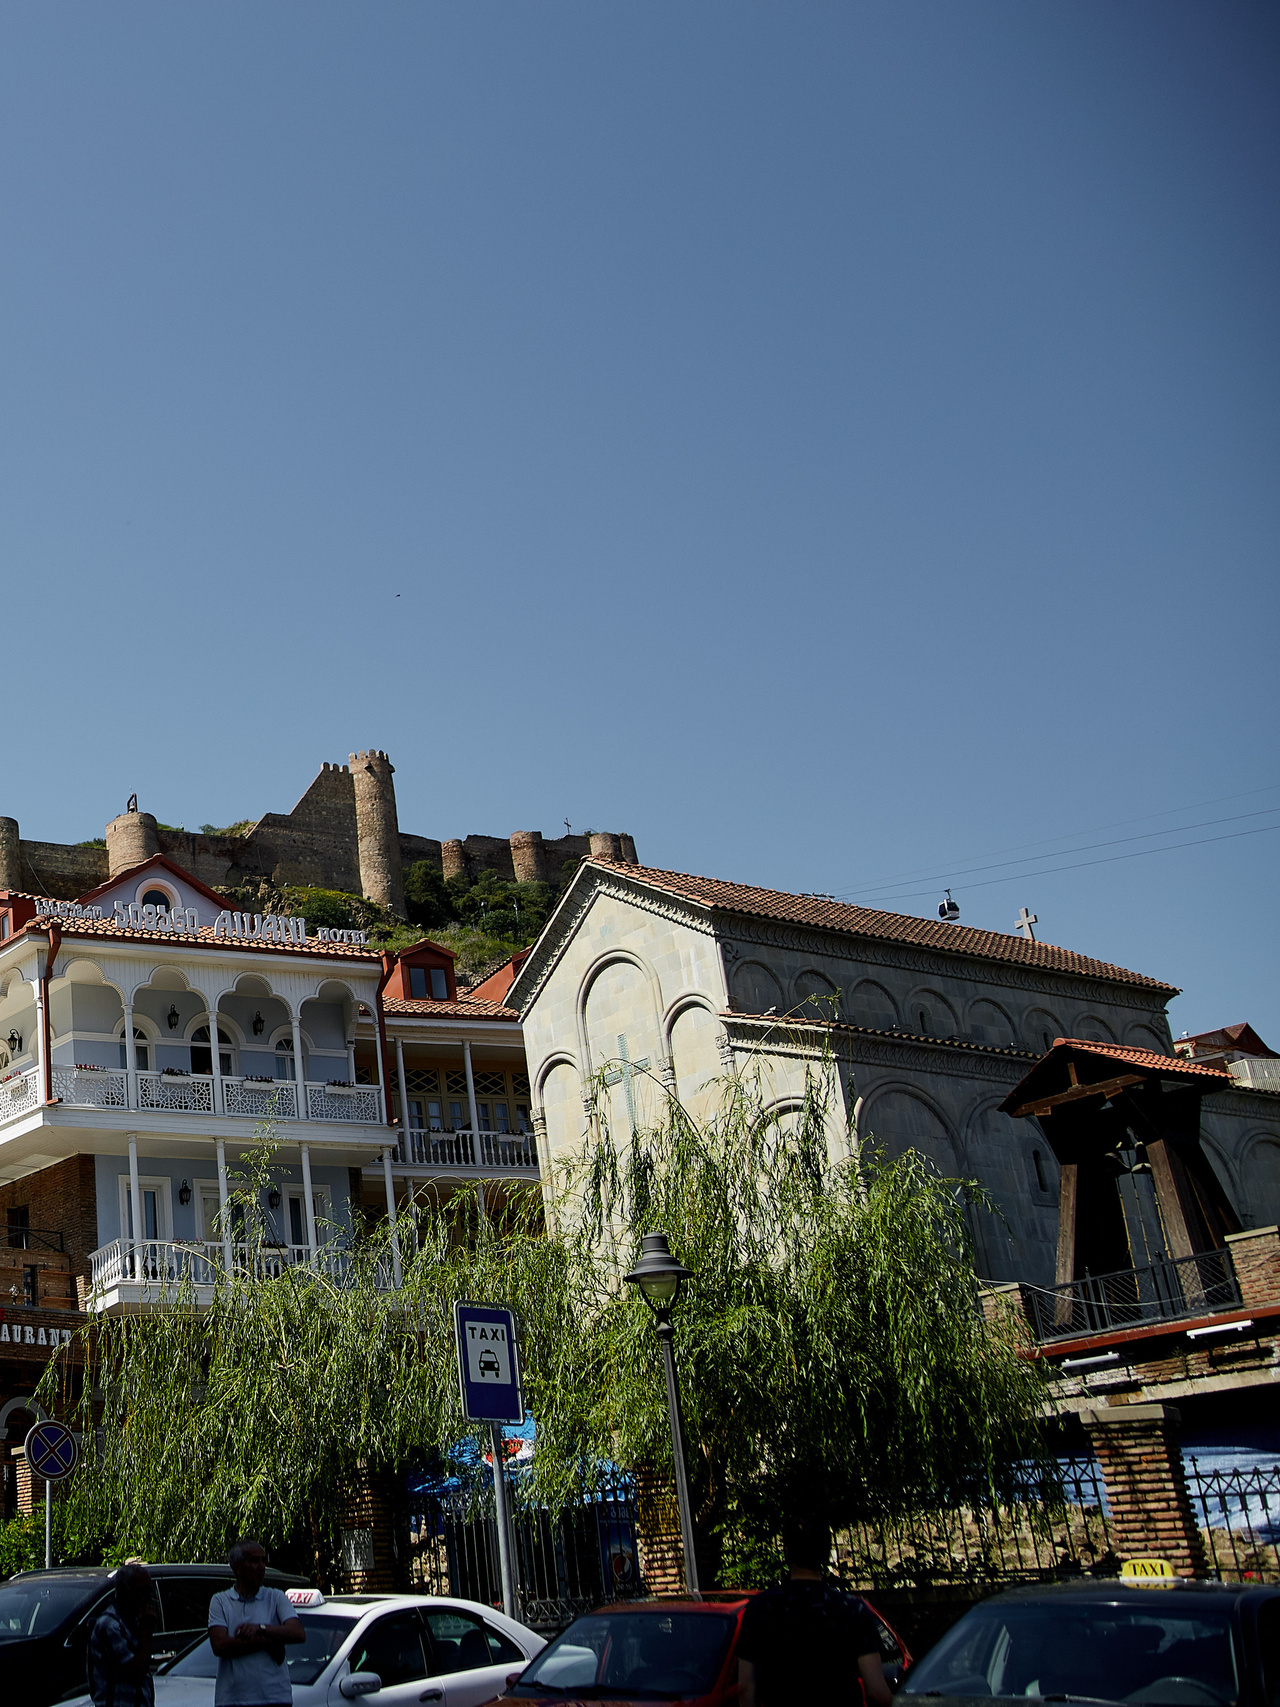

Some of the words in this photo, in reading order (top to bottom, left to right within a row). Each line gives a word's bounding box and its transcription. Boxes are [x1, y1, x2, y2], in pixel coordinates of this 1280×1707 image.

[114, 900, 199, 935] აივანი
[214, 910, 307, 944] AIVANI
[317, 927, 370, 945] HOTEL
[468, 1326, 505, 1341] TAXI
[1128, 1563, 1165, 1576] TAXI
[287, 1593, 314, 1604] TAXI
